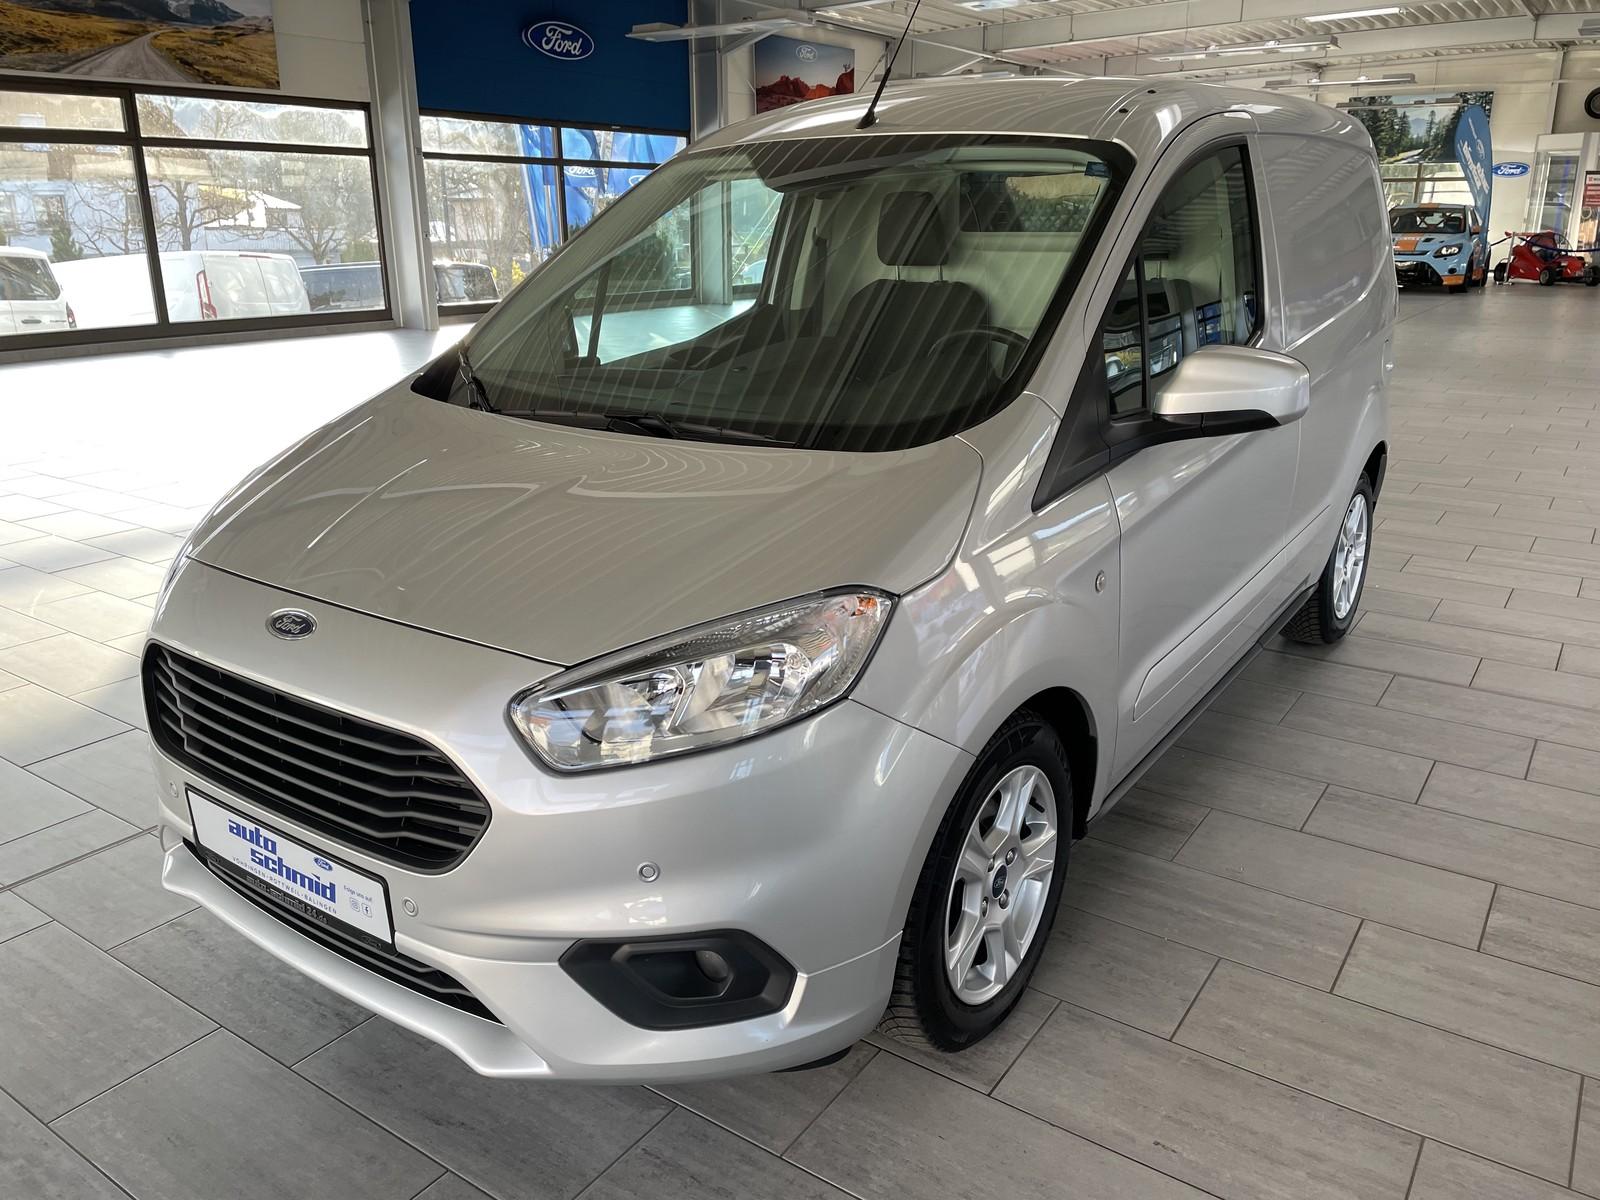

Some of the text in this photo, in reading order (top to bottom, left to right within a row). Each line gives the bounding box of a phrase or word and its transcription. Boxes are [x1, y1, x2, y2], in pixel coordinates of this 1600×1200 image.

[541, 25, 583, 56] Ford
[1497, 164, 1522, 176] Ford
[275, 615, 305, 634] Ford
[228, 818, 277, 856] auto
[250, 848, 336, 904] schmid
